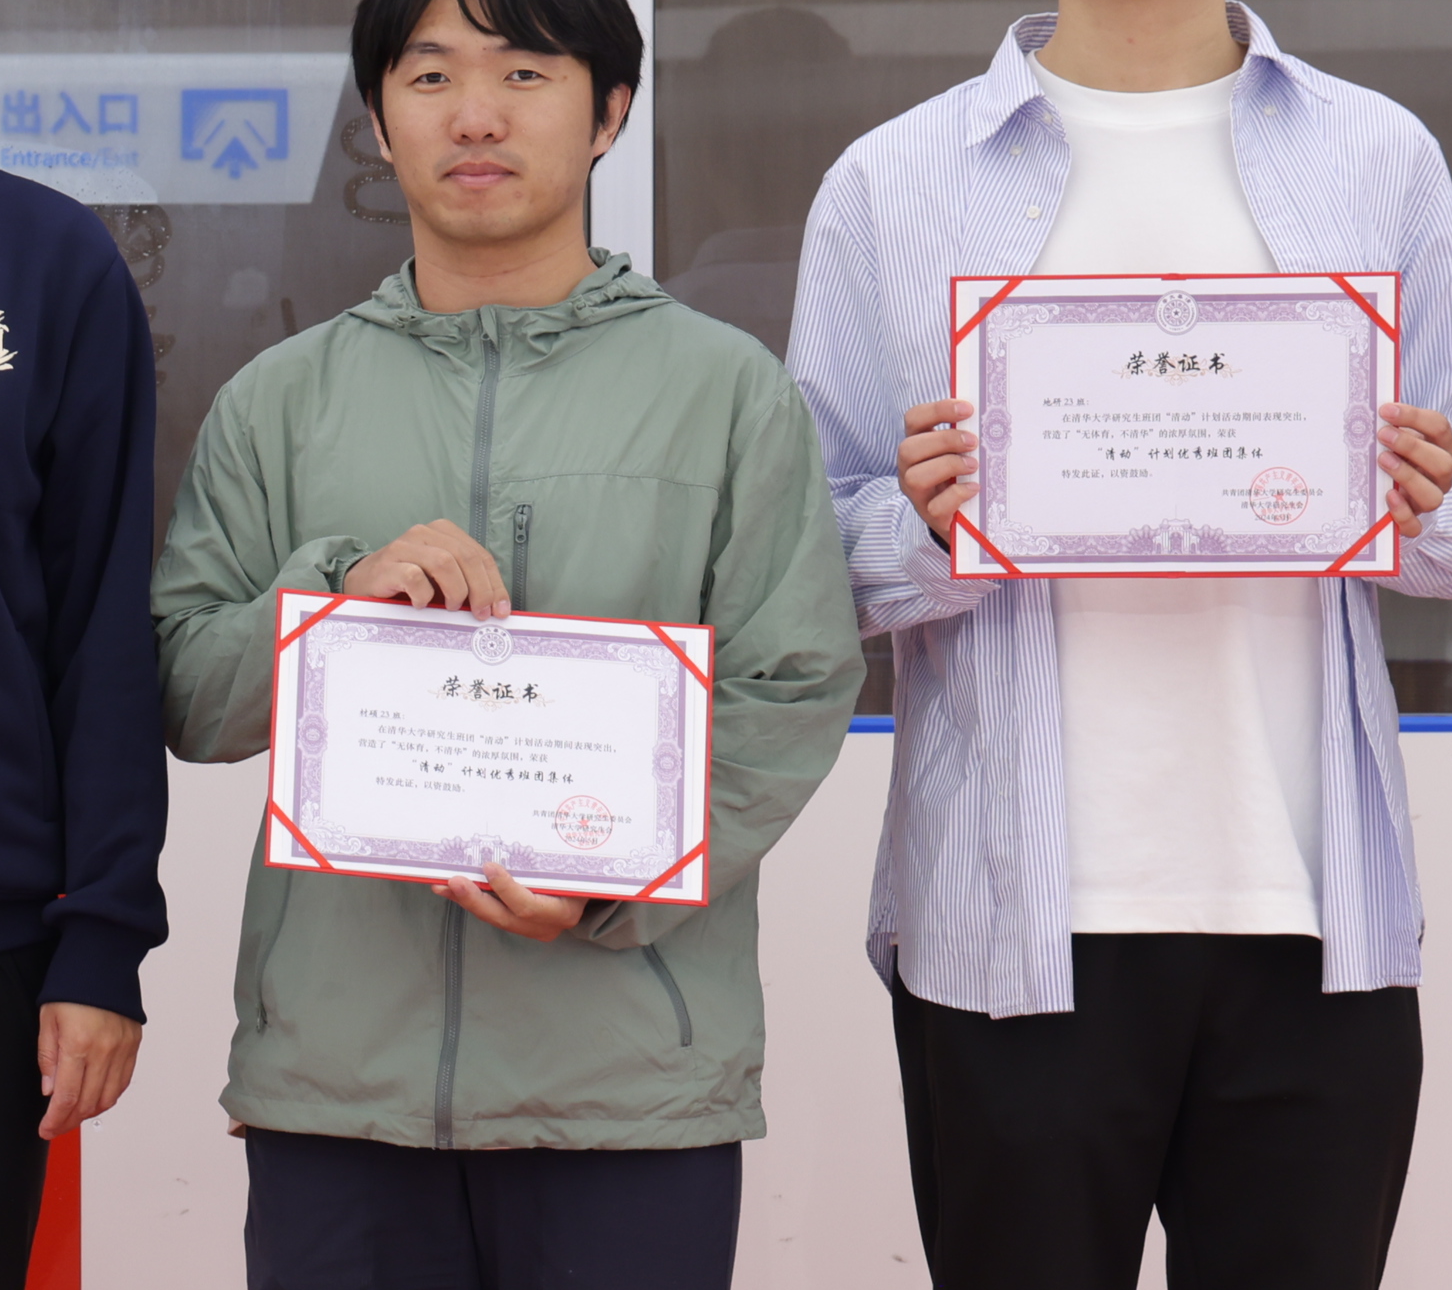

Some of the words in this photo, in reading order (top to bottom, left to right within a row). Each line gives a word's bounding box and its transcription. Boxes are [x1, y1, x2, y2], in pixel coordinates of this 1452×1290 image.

[2, 89, 139, 135] 出入口
[1126, 350, 1227, 376] 荣誉证书
[442, 675, 539, 704] 荣誉证书
